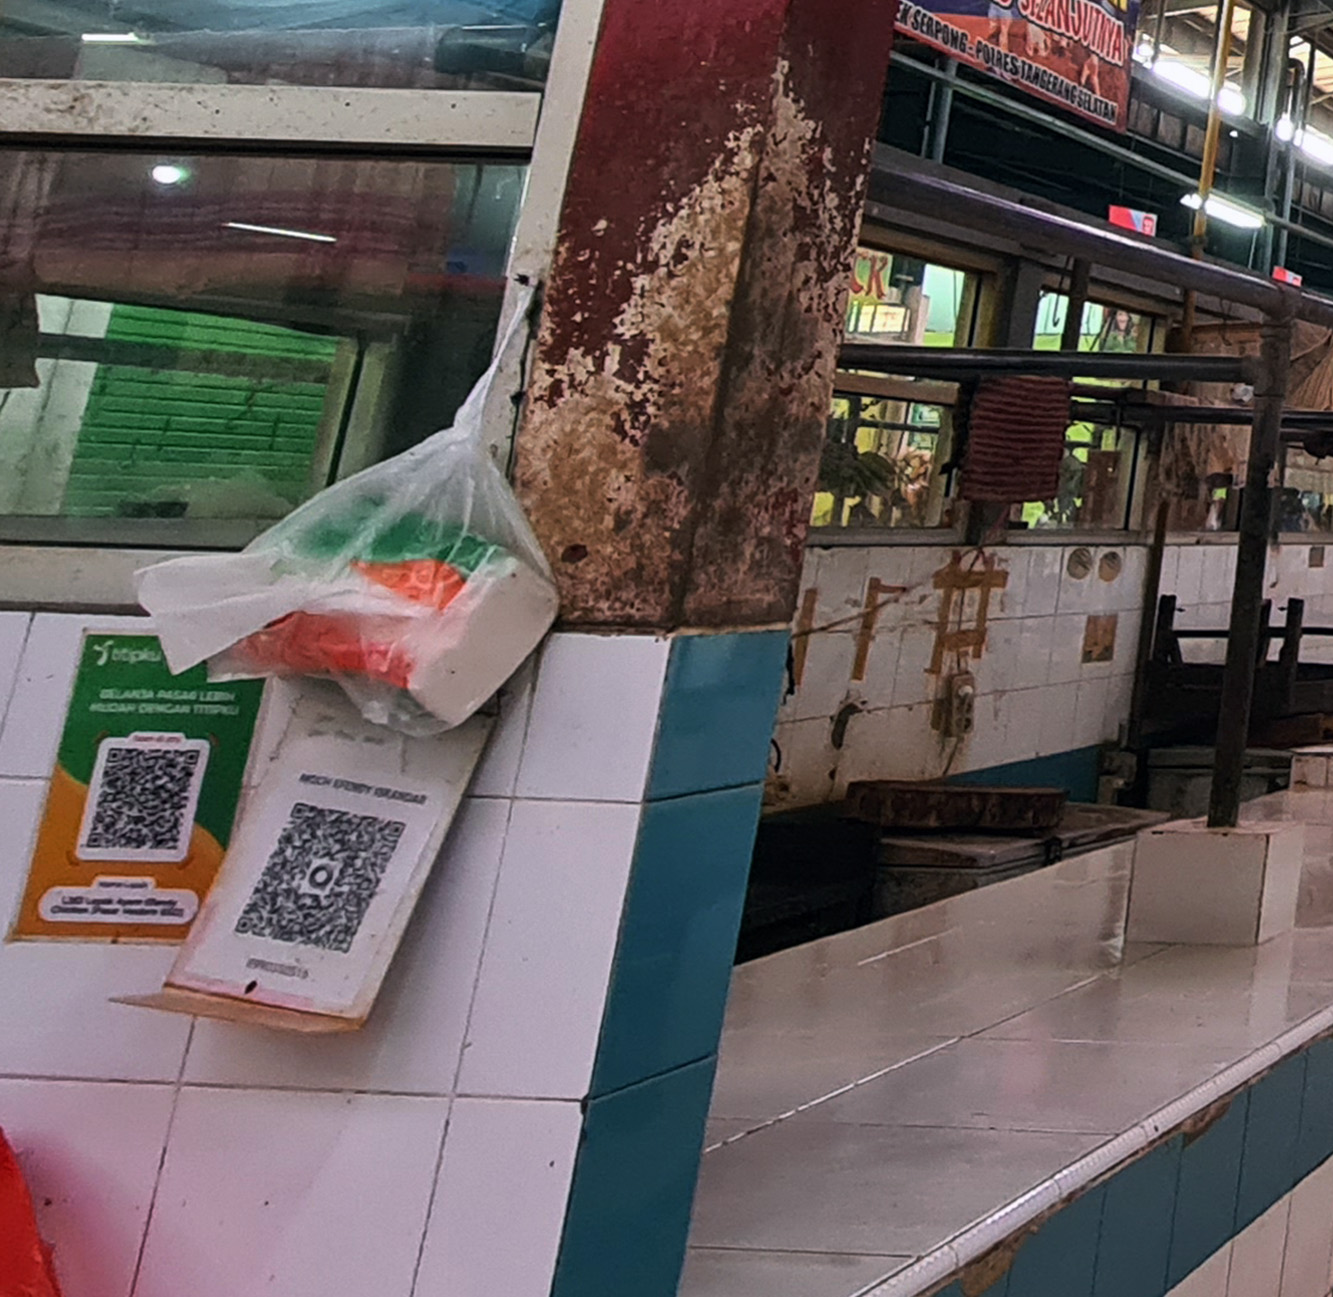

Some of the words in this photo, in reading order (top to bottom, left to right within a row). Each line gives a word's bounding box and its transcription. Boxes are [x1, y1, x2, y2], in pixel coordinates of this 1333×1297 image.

[911, 8, 968, 54] SERPONG
[1020, 58, 1076, 104] TANGERANG
[1077, 86, 1118, 123] SELATAN
